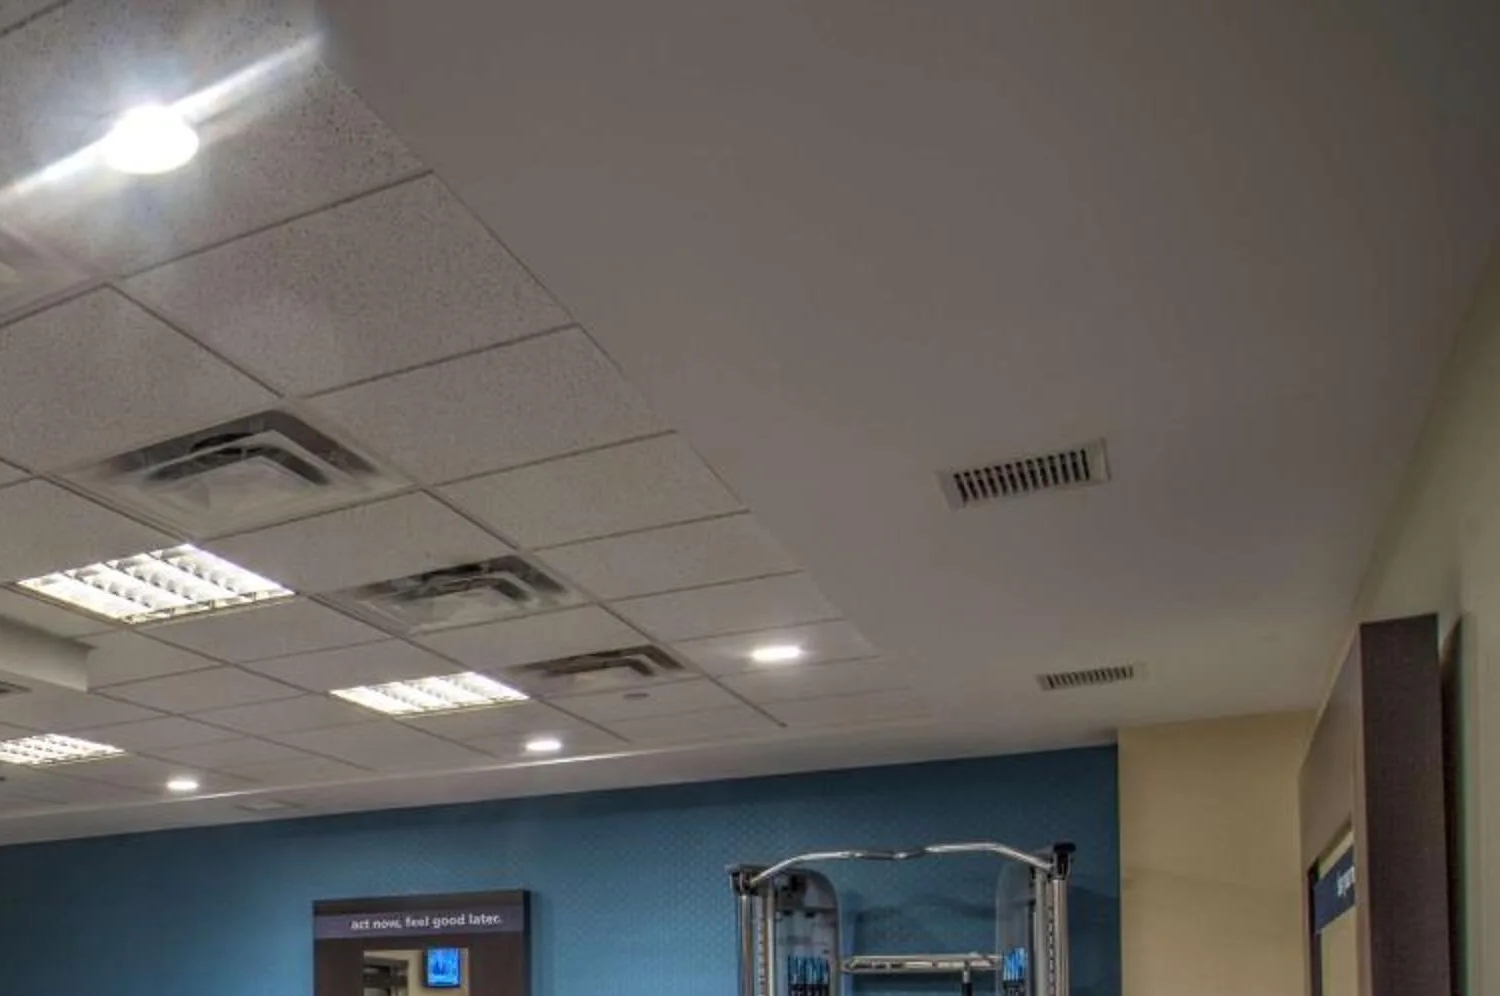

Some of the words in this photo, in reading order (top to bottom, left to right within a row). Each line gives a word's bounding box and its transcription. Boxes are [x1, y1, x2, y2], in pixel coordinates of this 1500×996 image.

[351, 919, 369, 930] act
[405, 915, 429, 928] feel
[431, 913, 466, 929] good
[469, 912, 502, 925] later.
